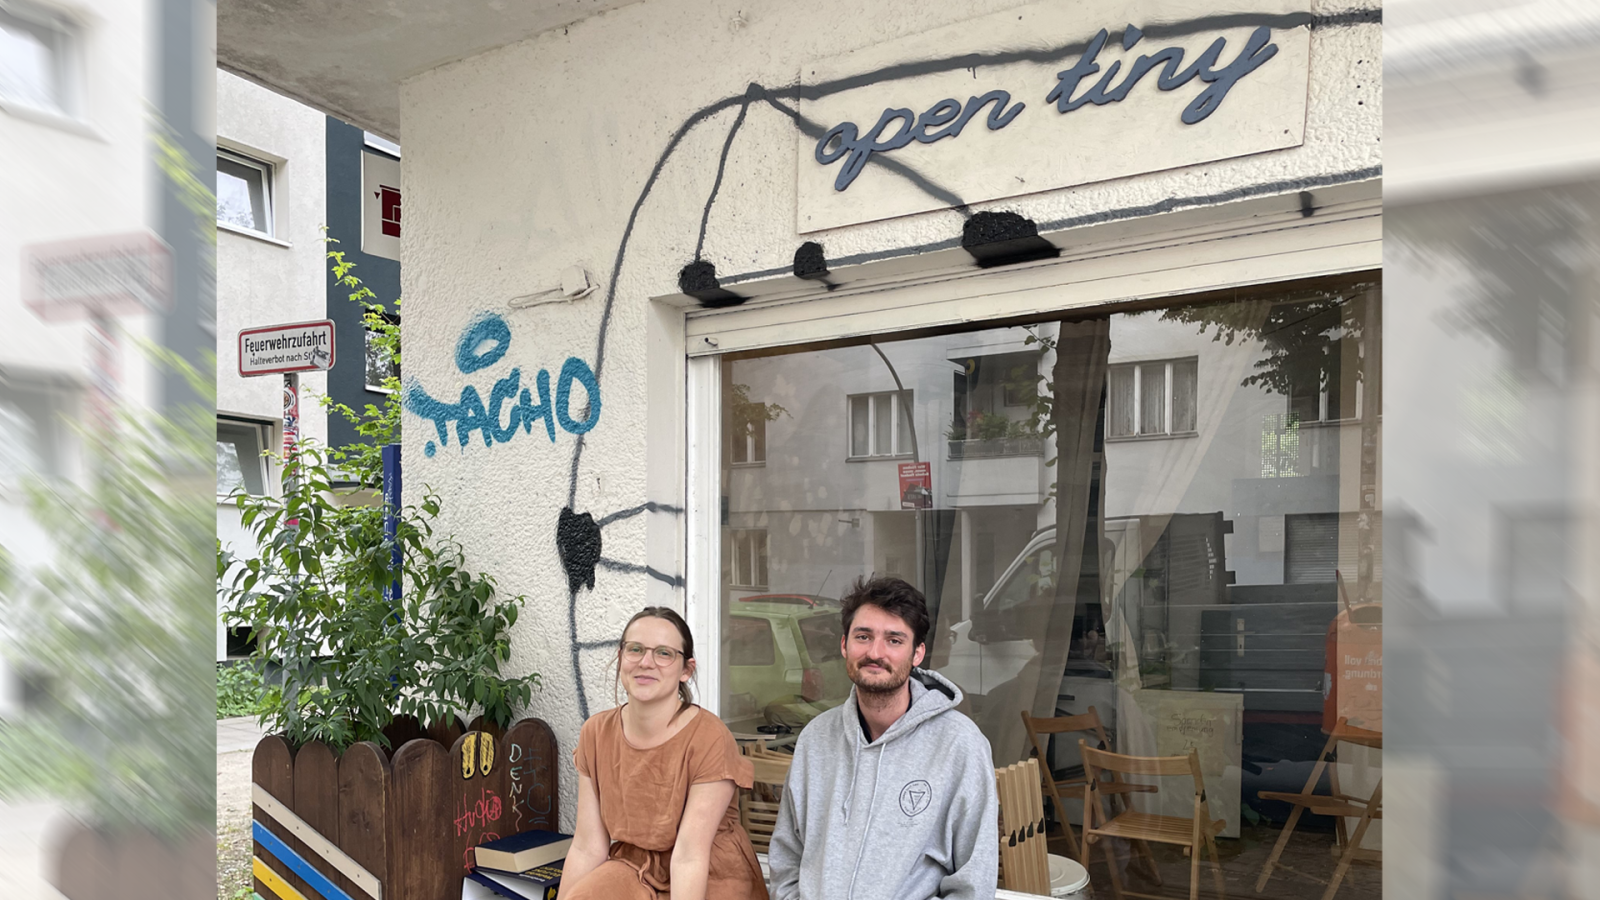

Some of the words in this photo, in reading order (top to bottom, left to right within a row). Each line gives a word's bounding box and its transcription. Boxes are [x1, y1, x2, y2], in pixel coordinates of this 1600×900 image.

[815, 88, 1026, 192] open
[1045, 23, 1279, 125] tiny
[245, 331, 326, 353] Feuerwehrzufahrt
[250, 353, 285, 365] Halteverbot
[286, 352, 302, 363] nach
